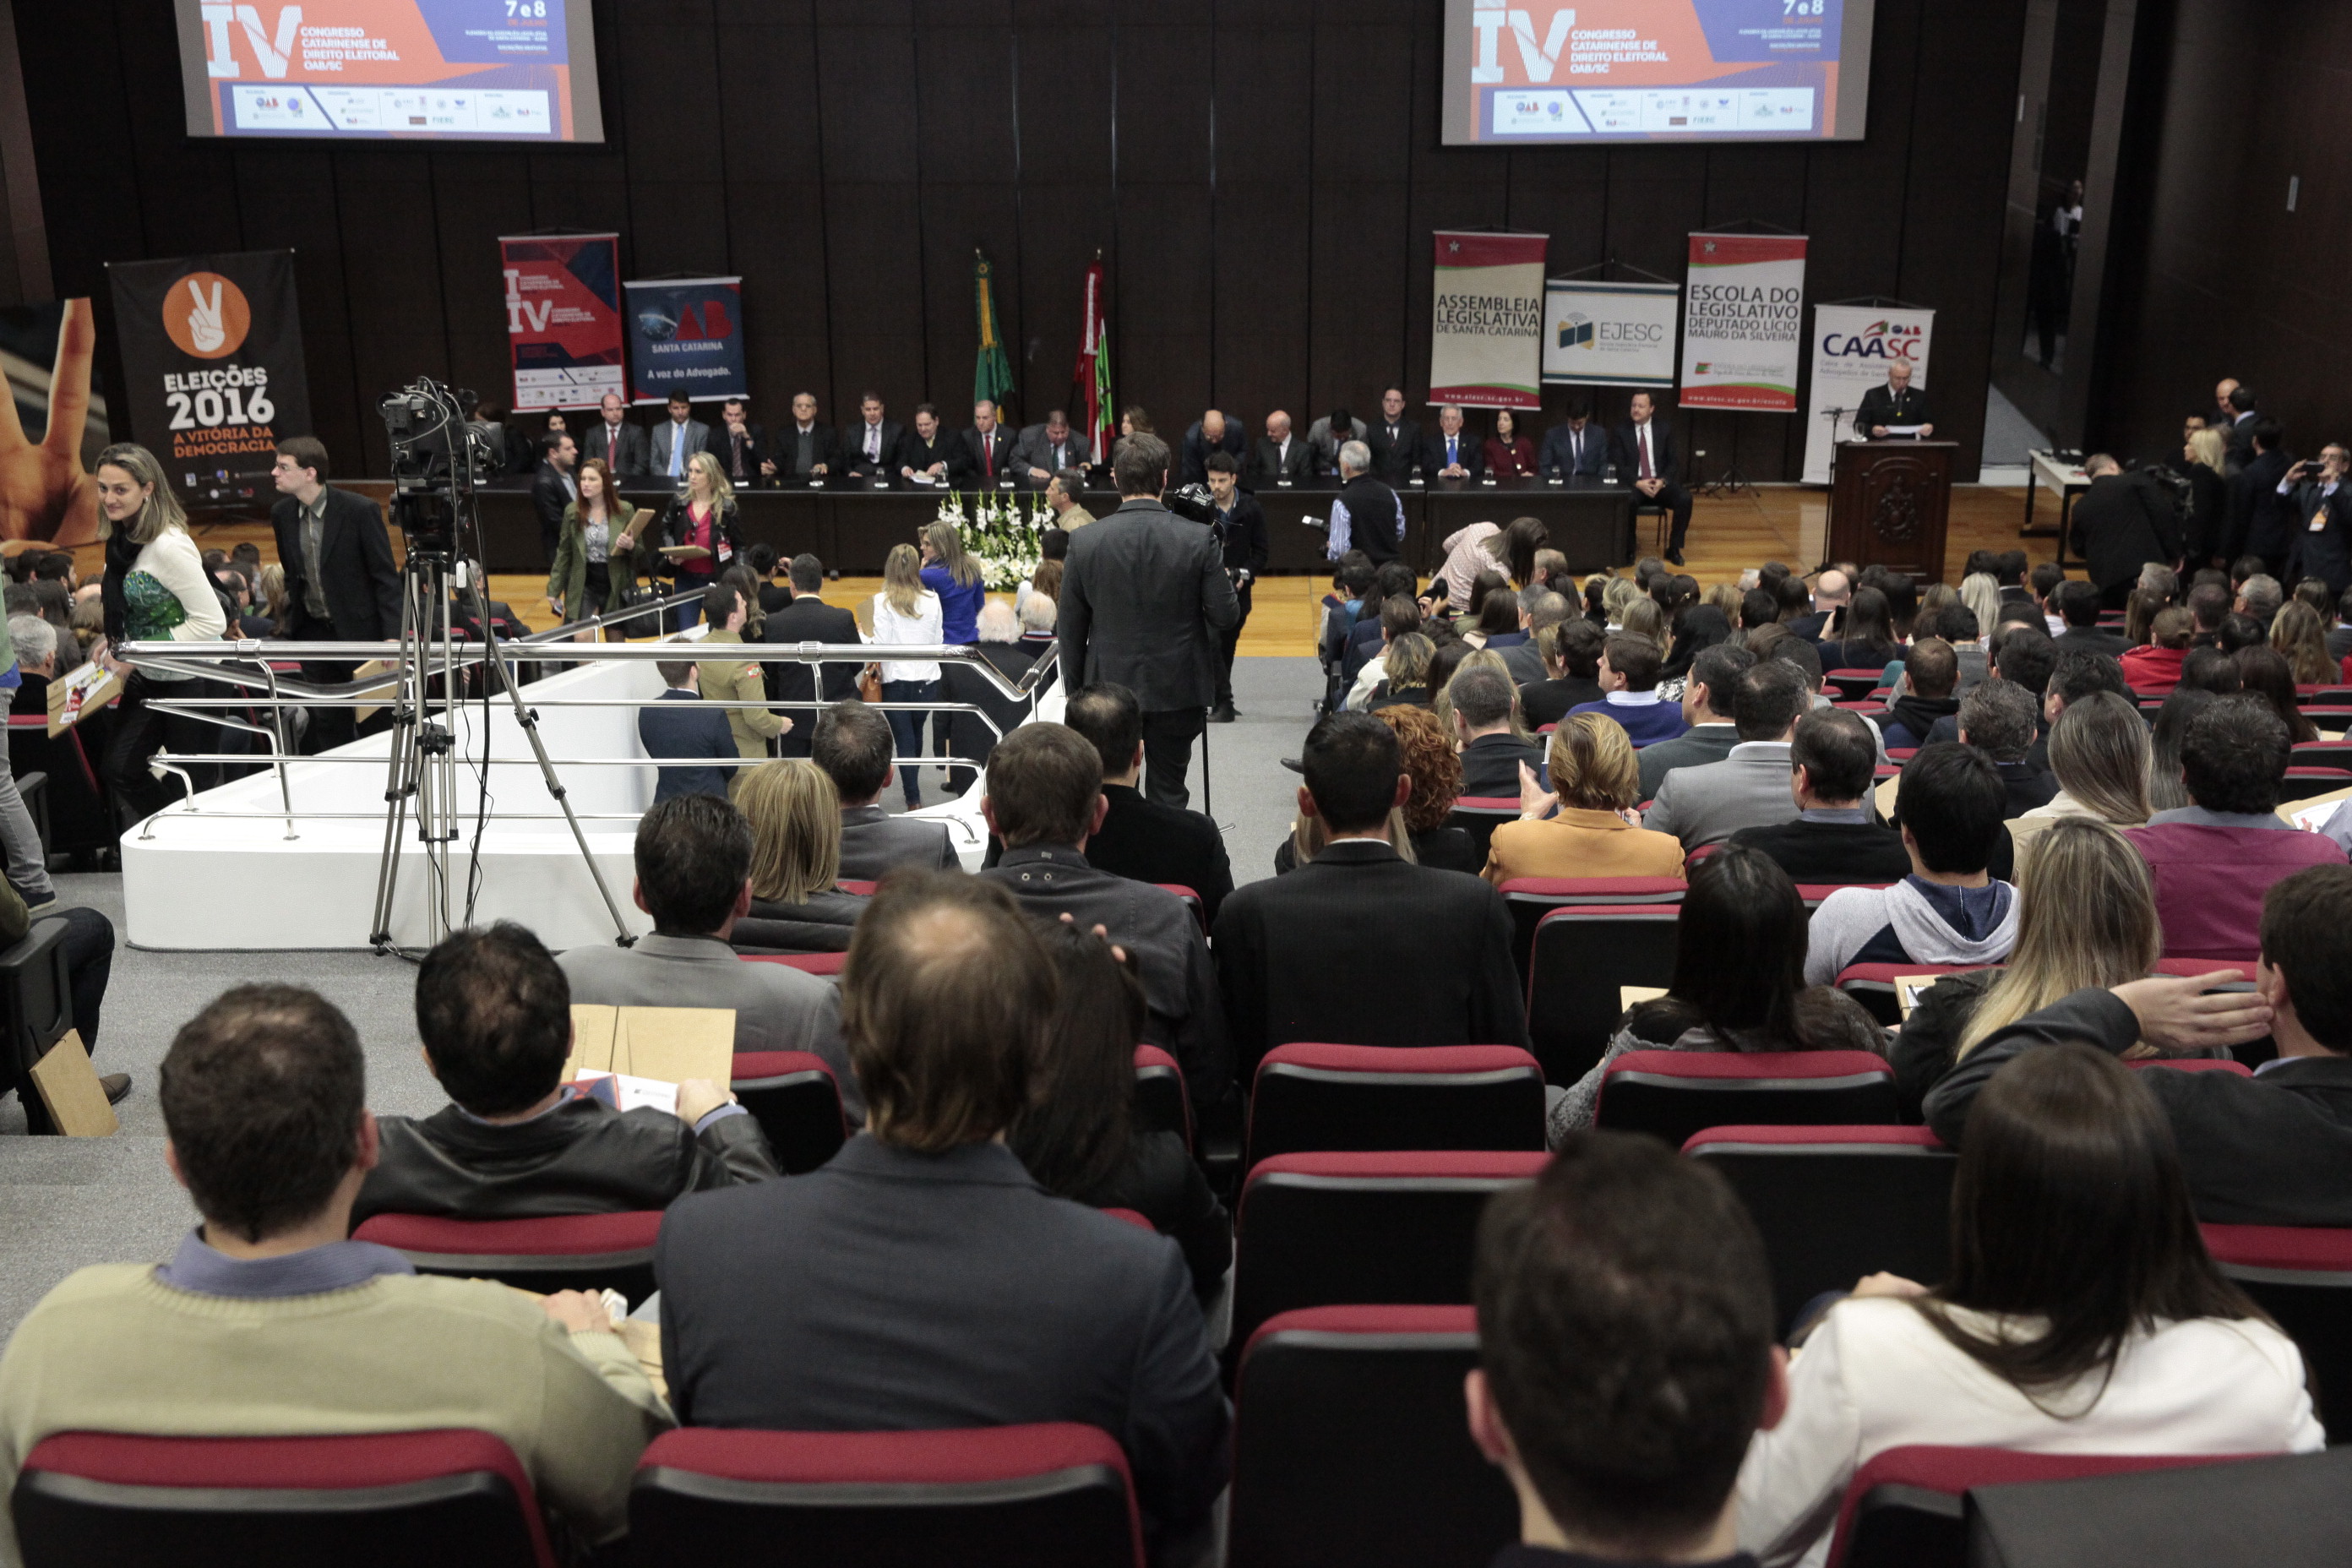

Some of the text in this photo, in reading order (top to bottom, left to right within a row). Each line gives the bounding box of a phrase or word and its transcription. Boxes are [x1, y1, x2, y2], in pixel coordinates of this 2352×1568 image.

[505, 0, 518, 17] 7
[533, 0, 546, 18] 8
[1811, 0, 1824, 15] 8
[301, 27, 364, 37] CONGRESSO
[1571, 30, 1636, 40] CONGRESSO
[201, 5, 302, 78] IV
[302, 38, 387, 49] CATARINENSE DE
[1472, 8, 1576, 84] IV
[1571, 41, 1658, 52] CATARINENSE DE
[303, 50, 400, 60] DIREITO ELEITORAL
[1571, 52, 1669, 63] DIREITO ELEITORAL
[304, 61, 343, 71] OAB/SC
[1571, 63, 1609, 74] OAB/SC
[1690, 285, 1799, 303] ESCOLA DO
[1437, 295, 1538, 312] ASSEMBLEIA
[1690, 302, 1798, 319] LEGISLATIVO
[506, 299, 553, 333] IV
[1437, 310, 1538, 327] LEGISLATIVA
[1436, 324, 1538, 337] DE SANTA CATARINA
[1600, 322, 1663, 342] EJESC
[1689, 317, 1797, 332] DEPUTADO LÍCIO
[1689, 329, 1796, 341] MAURO DA SILVEIRA
[651, 341, 723, 354] SANTA CATARINA
[1823, 334, 1921, 361] CAASC
[164, 364, 268, 392] ELEIÇÕES
[647, 369, 655, 379] A
[656, 370, 672, 378] voz
[166, 386, 275, 430] 2016
[174, 426, 274, 444] A VITÓRIA DA
[174, 439, 277, 458] DEMOCRACIA
